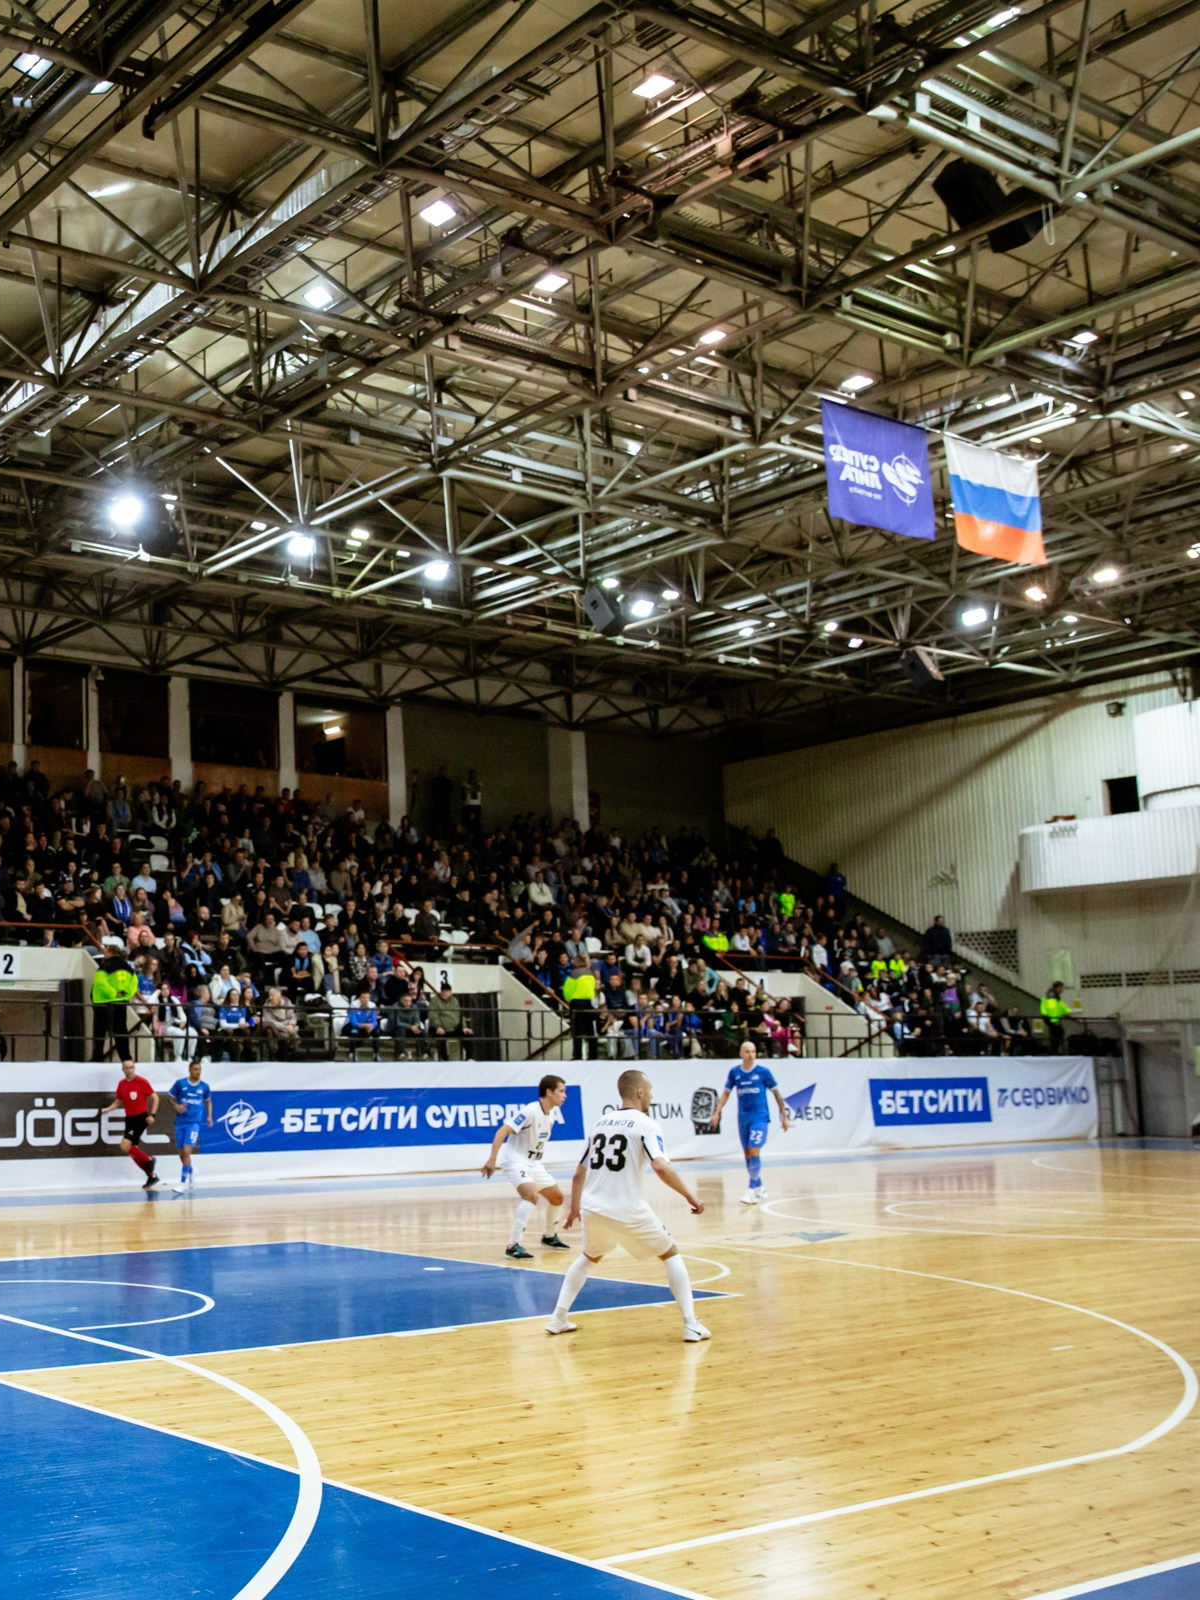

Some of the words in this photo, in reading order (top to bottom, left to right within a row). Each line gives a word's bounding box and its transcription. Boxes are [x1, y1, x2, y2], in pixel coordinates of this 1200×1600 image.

[3, 953, 14, 975] 2
[440, 970, 448, 985] 3
[878, 1088, 984, 1115] БЕТСИТИ
[280, 1105, 417, 1133] БЕТСИТИ
[590, 1133, 628, 1172] 33
